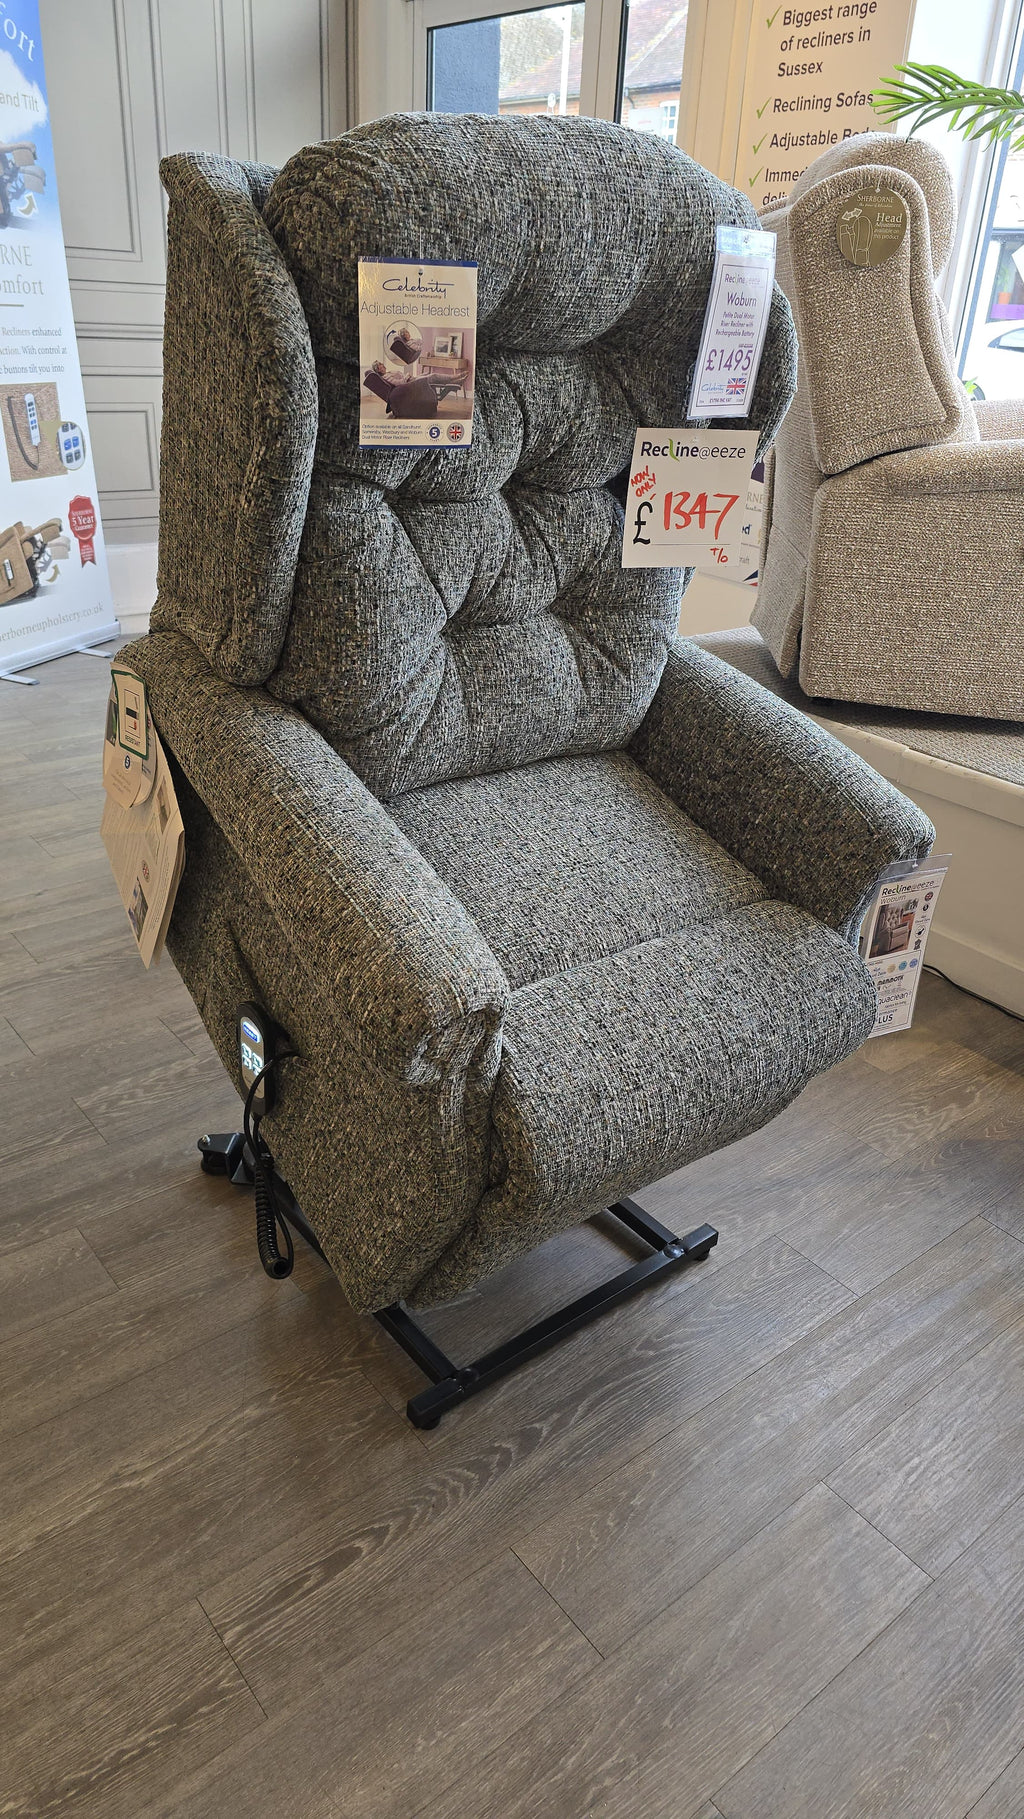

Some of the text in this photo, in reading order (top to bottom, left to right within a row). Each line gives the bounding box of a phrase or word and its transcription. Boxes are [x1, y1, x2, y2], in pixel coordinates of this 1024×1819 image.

[783, 1, 878, 28] Biggest range
[780, 26, 871, 52] of recliners in
[777, 61, 824, 77] Sussex
[21, 93, 40, 113] Tilt
[773, 90, 874, 112] Reclining Sofas
[769, 130, 838, 151] Adjustable
[857, 194, 895, 203] SHERBORNE
[876, 212, 903, 223] Head
[382, 276, 455, 299] Celebrity
[727, 291, 757, 307] Woburn
[360, 301, 470, 318] Adjustable Headrest
[31, 326, 62, 337] enhanced
[21, 345, 37, 356] With
[37, 345, 60, 356] control
[705, 348, 754, 372] £1495
[4, 364, 28, 376] buttons
[39, 364, 51, 376] you
[51, 363, 65, 374] into
[640, 438, 746, 462] Recline@eeze
[630, 465, 651, 487] NOW
[635, 473, 657, 498] ONLY
[77, 514, 95, 526] Year
[663, 491, 741, 541] 1347
